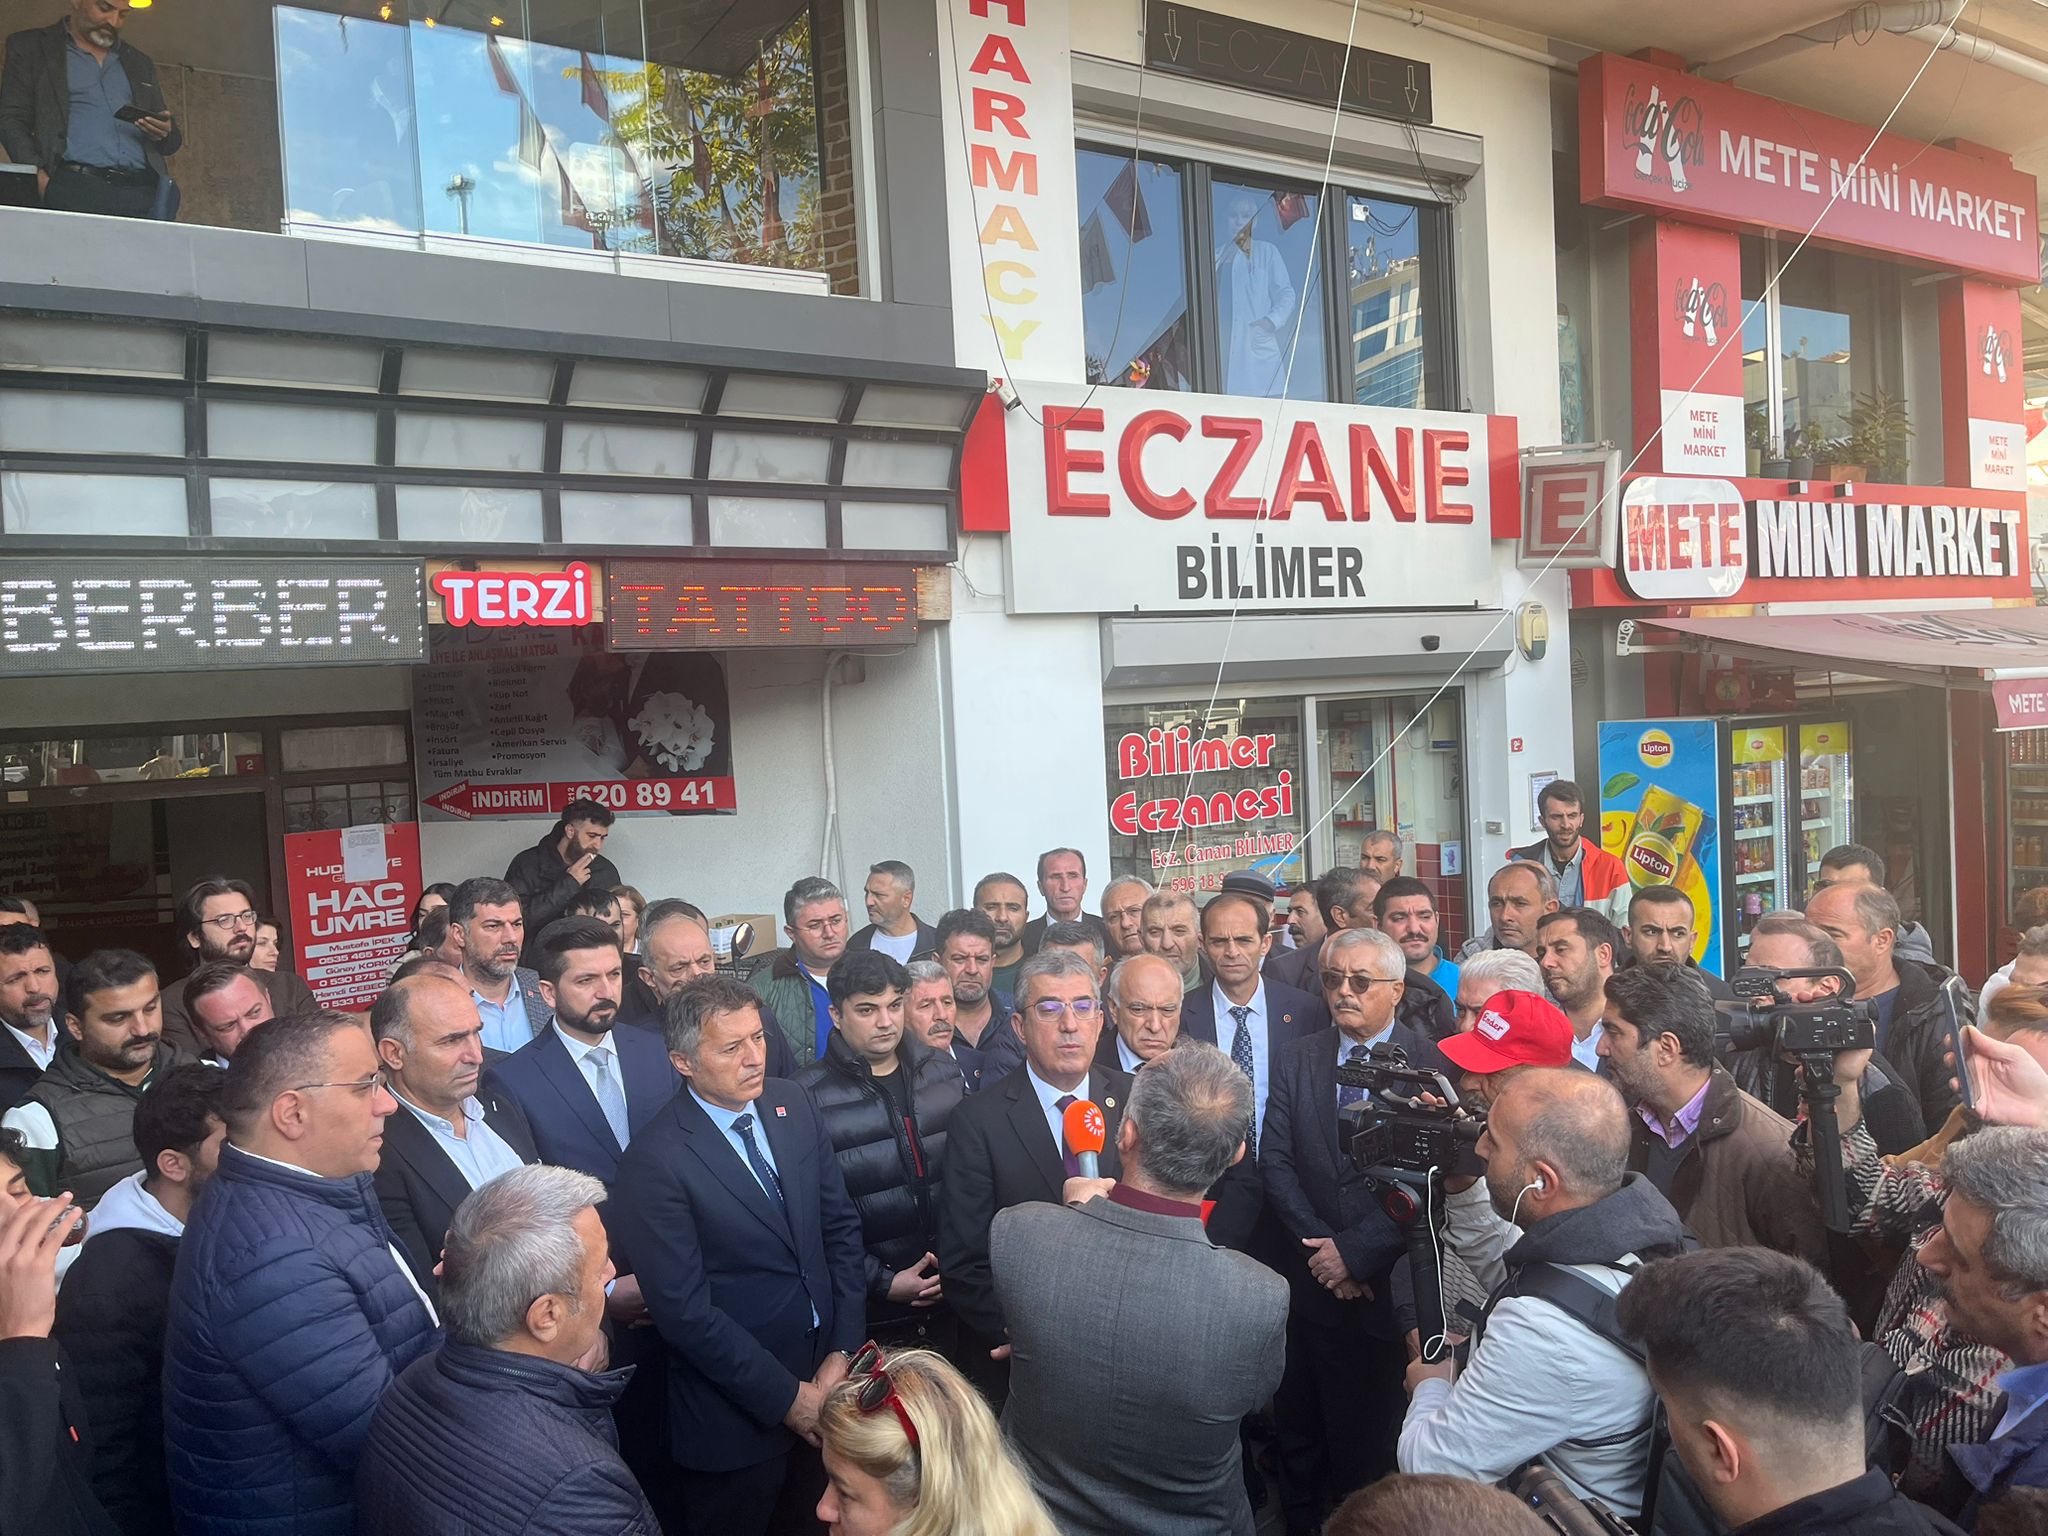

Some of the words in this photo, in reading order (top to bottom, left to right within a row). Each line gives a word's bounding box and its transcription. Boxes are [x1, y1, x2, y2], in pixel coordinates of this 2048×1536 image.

[1196, 19, 1393, 104] ECZANE
[1720, 129, 1820, 194] METE
[1830, 154, 1900, 212] MİNİ
[1910, 178, 2026, 241] MARKET
[1690, 409, 1719, 423] METE
[1693, 425, 1716, 440] MİNİ
[1988, 434, 2009, 447] METE
[1041, 404, 1474, 525] ECZANE
[1683, 444, 1727, 458] MARKET
[1984, 463, 2015, 476] MARKET
[1540, 478, 1588, 544] E
[1626, 503, 1743, 571] METE
[1866, 503, 2021, 577] MARKET
[1175, 532, 1367, 600] BİLİMER
[441, 569, 586, 619] TERZİ
[620, 585, 907, 632] TATTOO
[1, 579, 400, 652] BERBER
[2008, 693, 2046, 713] METE
[495, 739, 538, 748] Amerikan
[540, 738, 568, 746] Servis
[496, 752, 546, 761] Promosyon
[1118, 725, 1276, 780] Bilimer
[1643, 743, 1669, 754] Lipton
[433, 770, 452, 778] Tüm
[486, 767, 522, 777] Evraklar
[576, 783, 627, 807] 620
[636, 782, 672, 807] 89
[680, 780, 715, 805] 41
[1110, 769, 1294, 836] Eczanesi
[1151, 848, 1182, 869] Ecz.
[1184, 843, 1232, 865] Canan
[1234, 830, 1294, 858] BİLİMER
[1632, 847, 1671, 877] Lipton
[1170, 875, 1196, 893] 596
[1200, 872, 1214, 890] 18
[308, 882, 406, 916] HAC
[310, 907, 407, 937] UMRE
